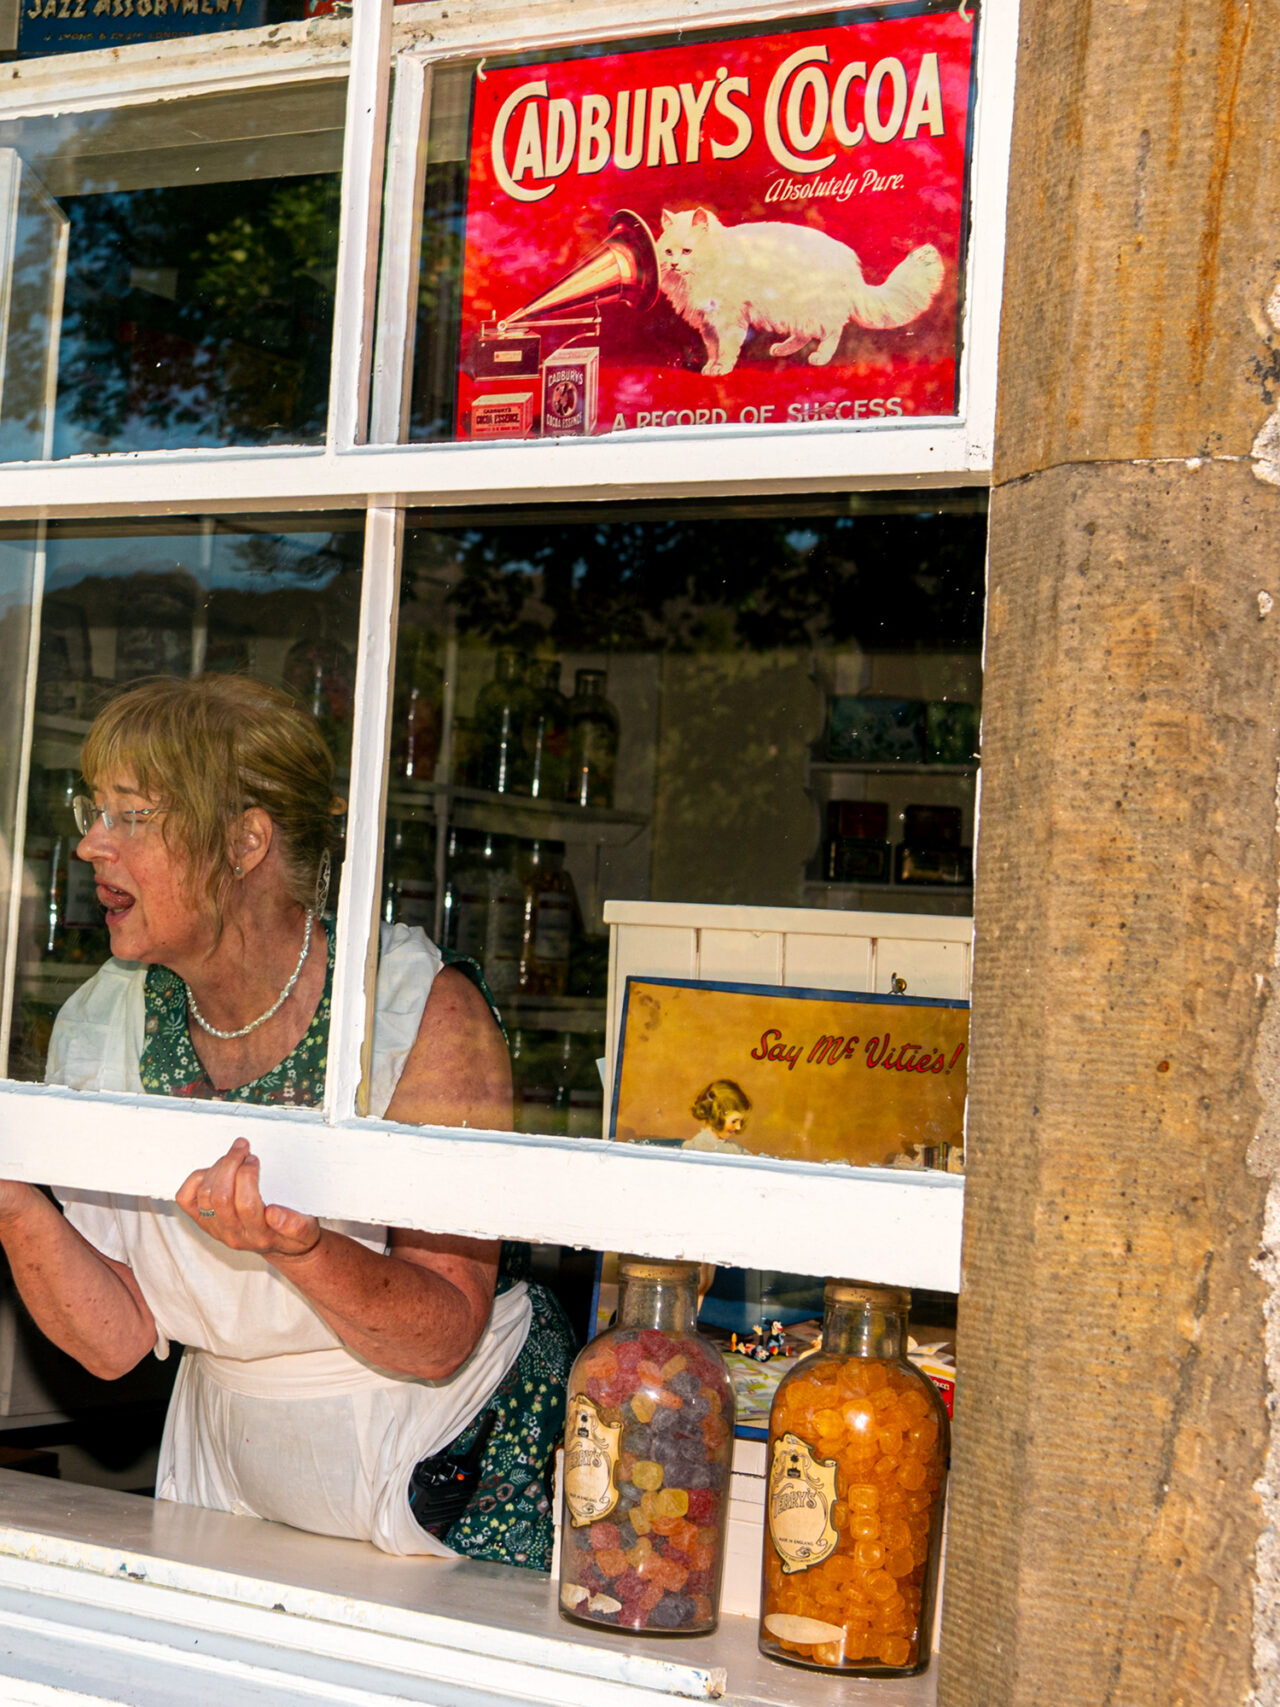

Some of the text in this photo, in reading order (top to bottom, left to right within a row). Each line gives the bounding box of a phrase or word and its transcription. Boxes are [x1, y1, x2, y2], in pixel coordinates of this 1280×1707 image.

[26, 0, 243, 19] JAZZ ASSORTMENT
[491, 44, 946, 203] CADBURY'S COCOA
[764, 168, 905, 203] Absolutely Pure.
[611, 397, 904, 432] A RECORD OF SUCCESS
[750, 1028, 804, 1071] Say
[864, 1032, 965, 1075] Vitie's!
